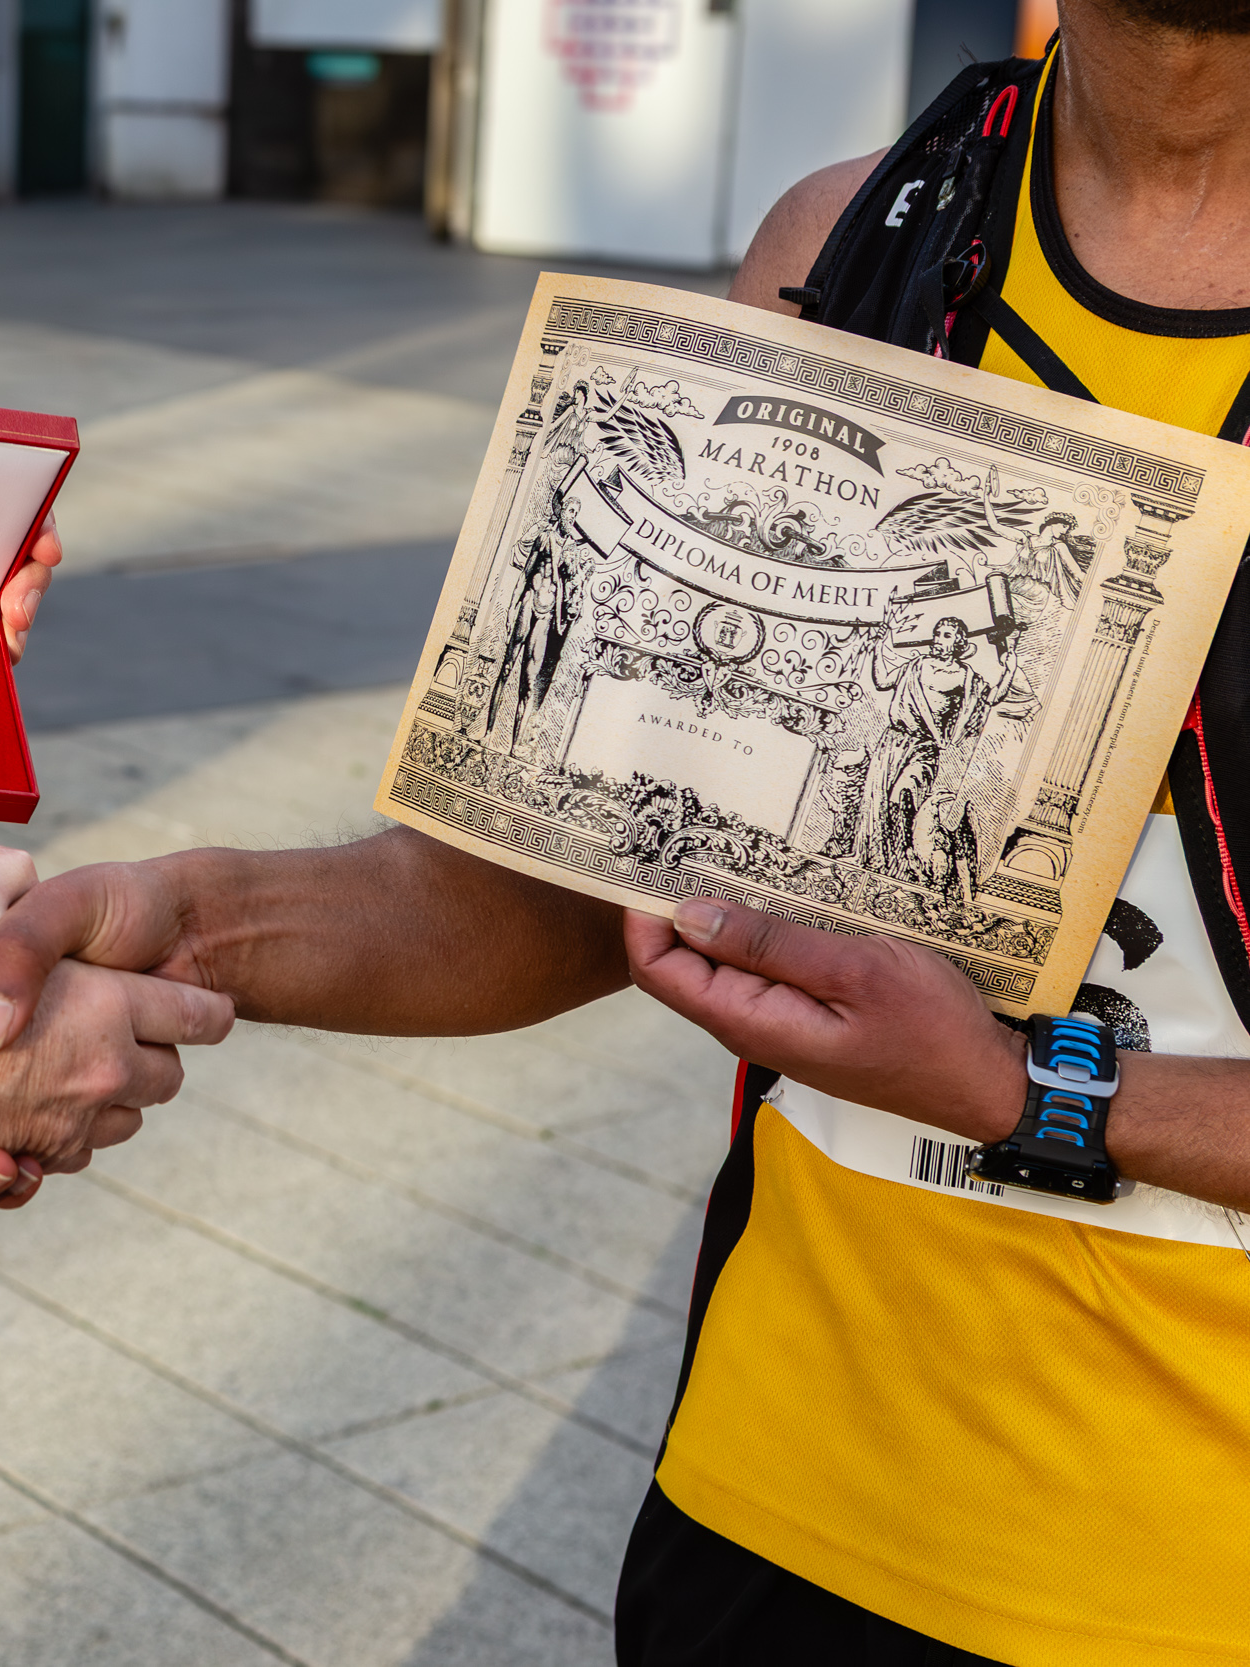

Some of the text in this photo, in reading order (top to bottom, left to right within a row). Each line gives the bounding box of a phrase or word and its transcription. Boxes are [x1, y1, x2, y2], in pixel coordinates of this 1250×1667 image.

[736, 401, 866, 454] ORIGINAL
[771, 436, 820, 461] 1908
[698, 438, 880, 510] MARATHON
[635, 517, 879, 607] DIPLOMA OF MERIT
[1142, 619, 1161, 656] Designed
[1132, 656, 1146, 678] using
[1126, 678, 1138, 701] assets
[1118, 702, 1132, 722] from
[637, 713, 754, 756] AWARDED TO
[1102, 722, 1125, 768] freepik.com
[1096, 769, 1106, 785] and
